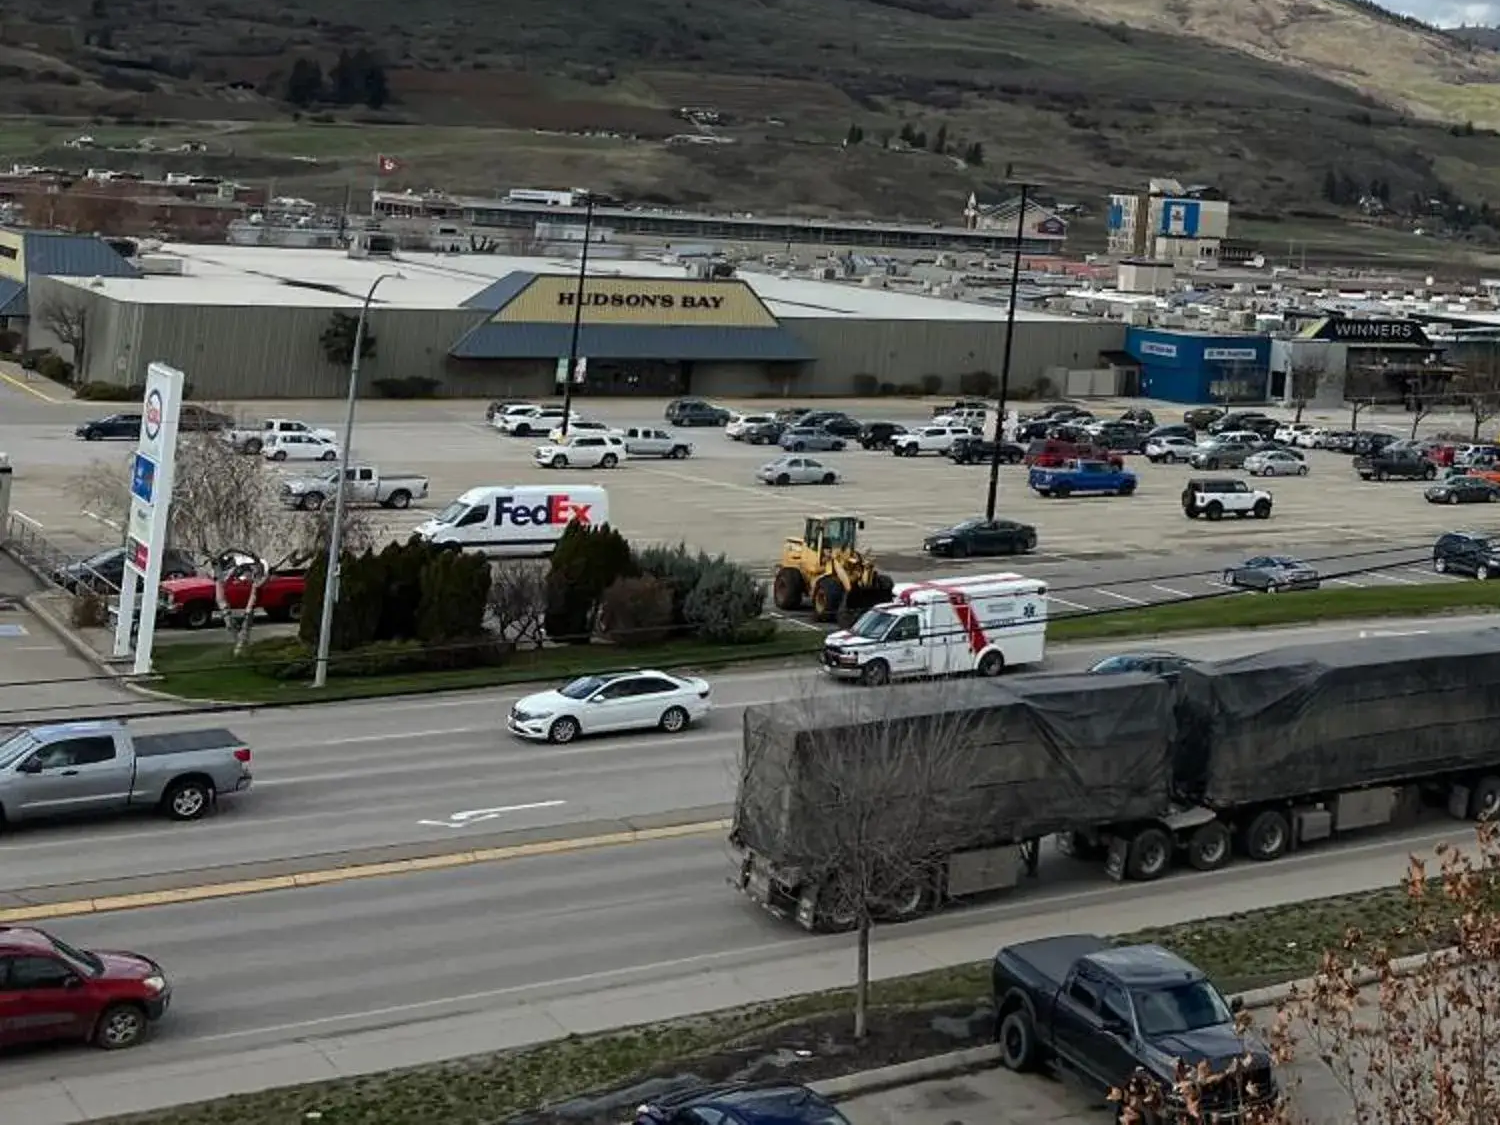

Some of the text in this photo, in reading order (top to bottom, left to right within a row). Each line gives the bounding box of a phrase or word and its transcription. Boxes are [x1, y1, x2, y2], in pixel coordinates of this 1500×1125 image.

[558, 292, 725, 309] HUDSON'S BAY
[1335, 323, 1412, 337] WINNERS
[494, 494, 592, 526] FedEx
